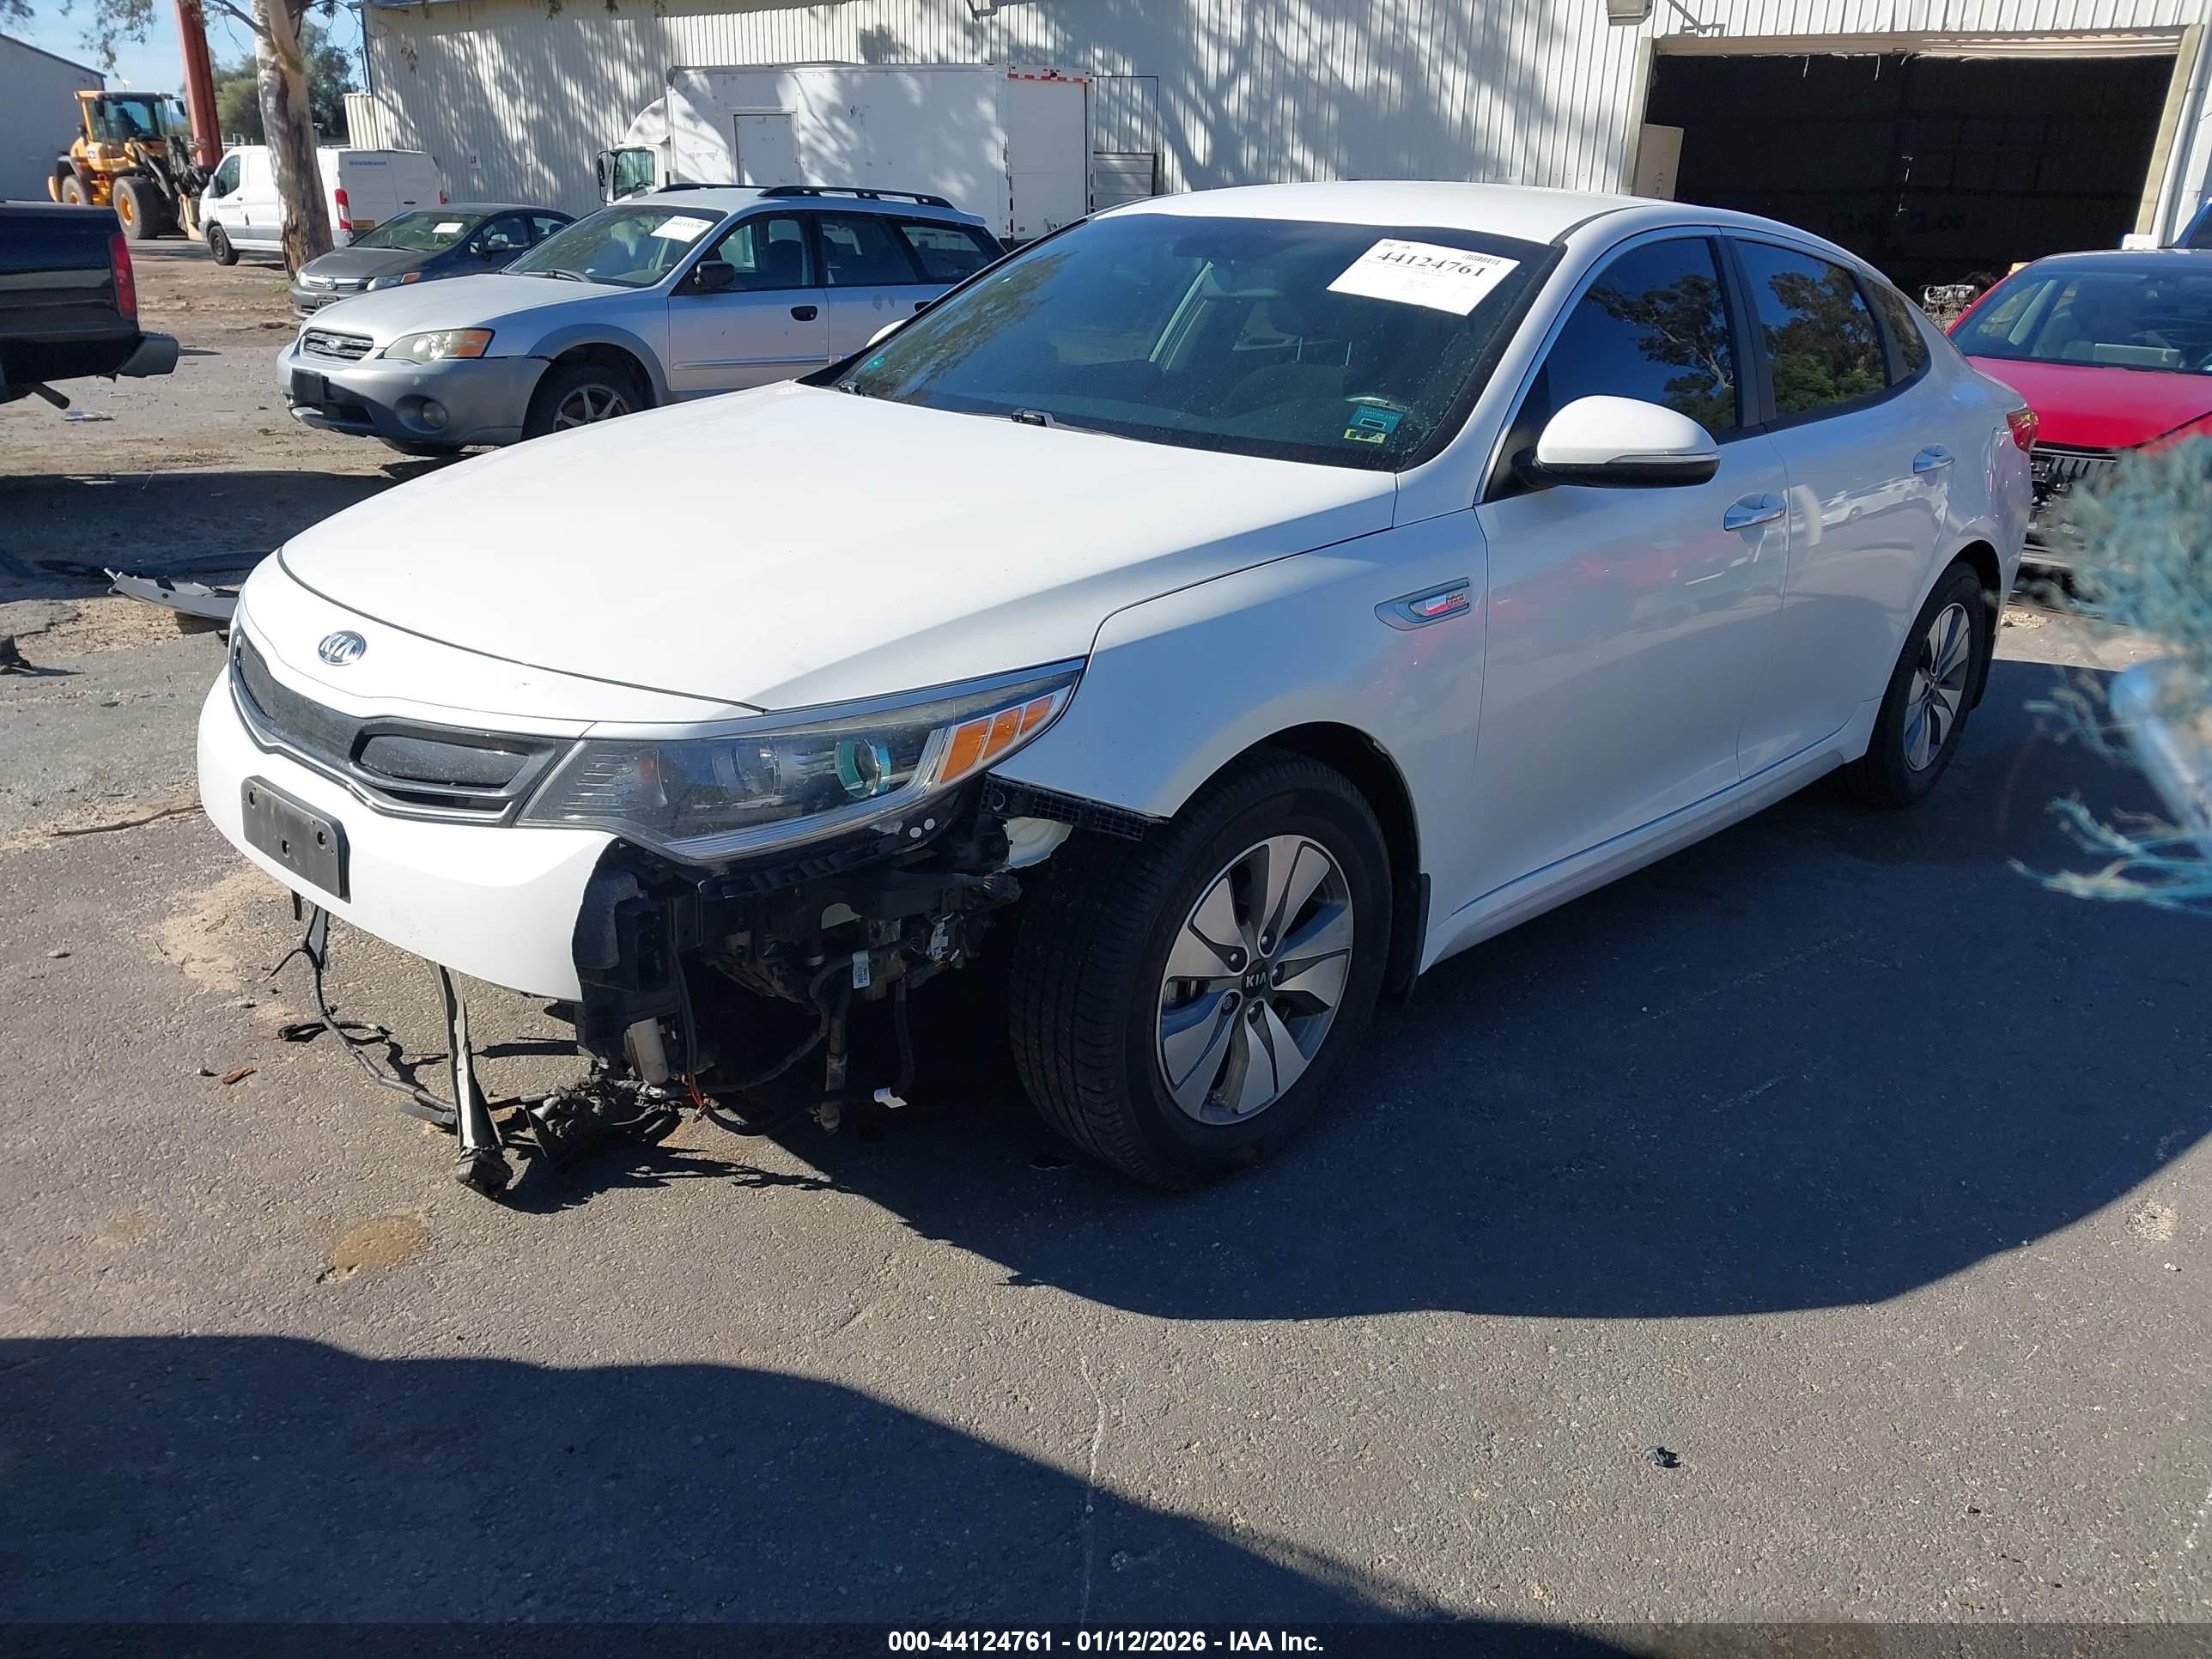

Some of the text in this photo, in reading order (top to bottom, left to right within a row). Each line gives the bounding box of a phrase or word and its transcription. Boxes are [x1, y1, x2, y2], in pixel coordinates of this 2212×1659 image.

[1376, 252, 1486, 277] 44124761
[319, 634, 358, 663] KIA
[1245, 972, 1267, 988] KIA
